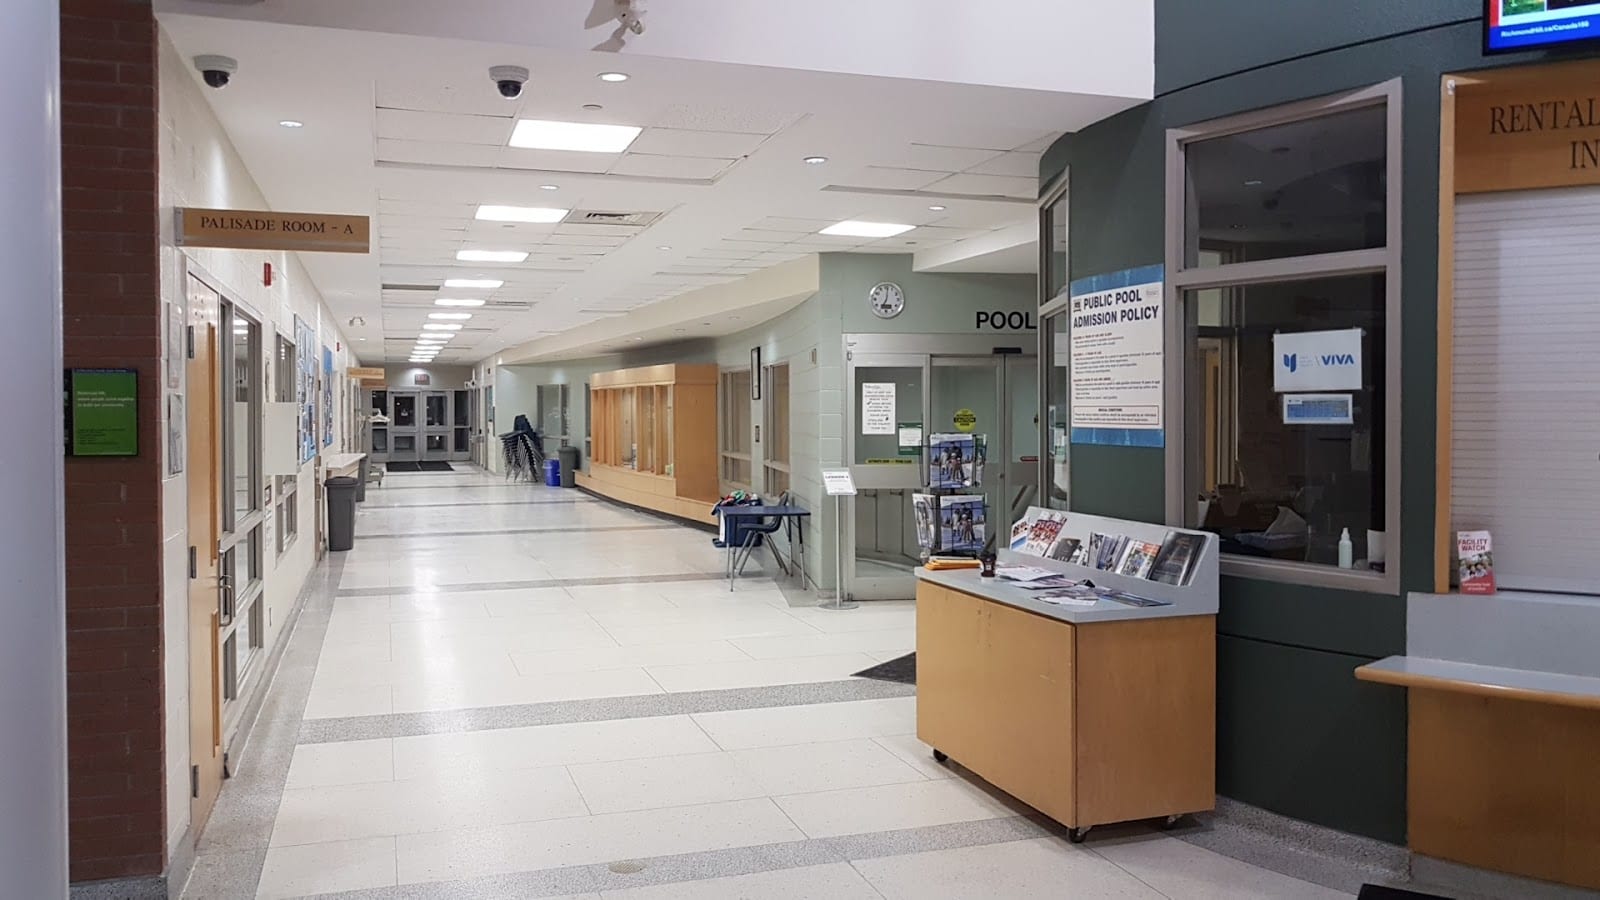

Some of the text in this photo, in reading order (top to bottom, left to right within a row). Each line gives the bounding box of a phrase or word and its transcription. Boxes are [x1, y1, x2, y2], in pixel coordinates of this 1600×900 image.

[1489, 97, 1600, 135] RENTAL
[201, 216, 276, 232] PALISADE
[282, 220, 326, 234] ROOM
[343, 223, 353, 235] A
[1083, 289, 1142, 310] PUBLIC POOL
[976, 311, 1037, 330] POOL
[1073, 305, 1159, 329] ADMISSION POLICY
[1321, 353, 1355, 366] VIVA
